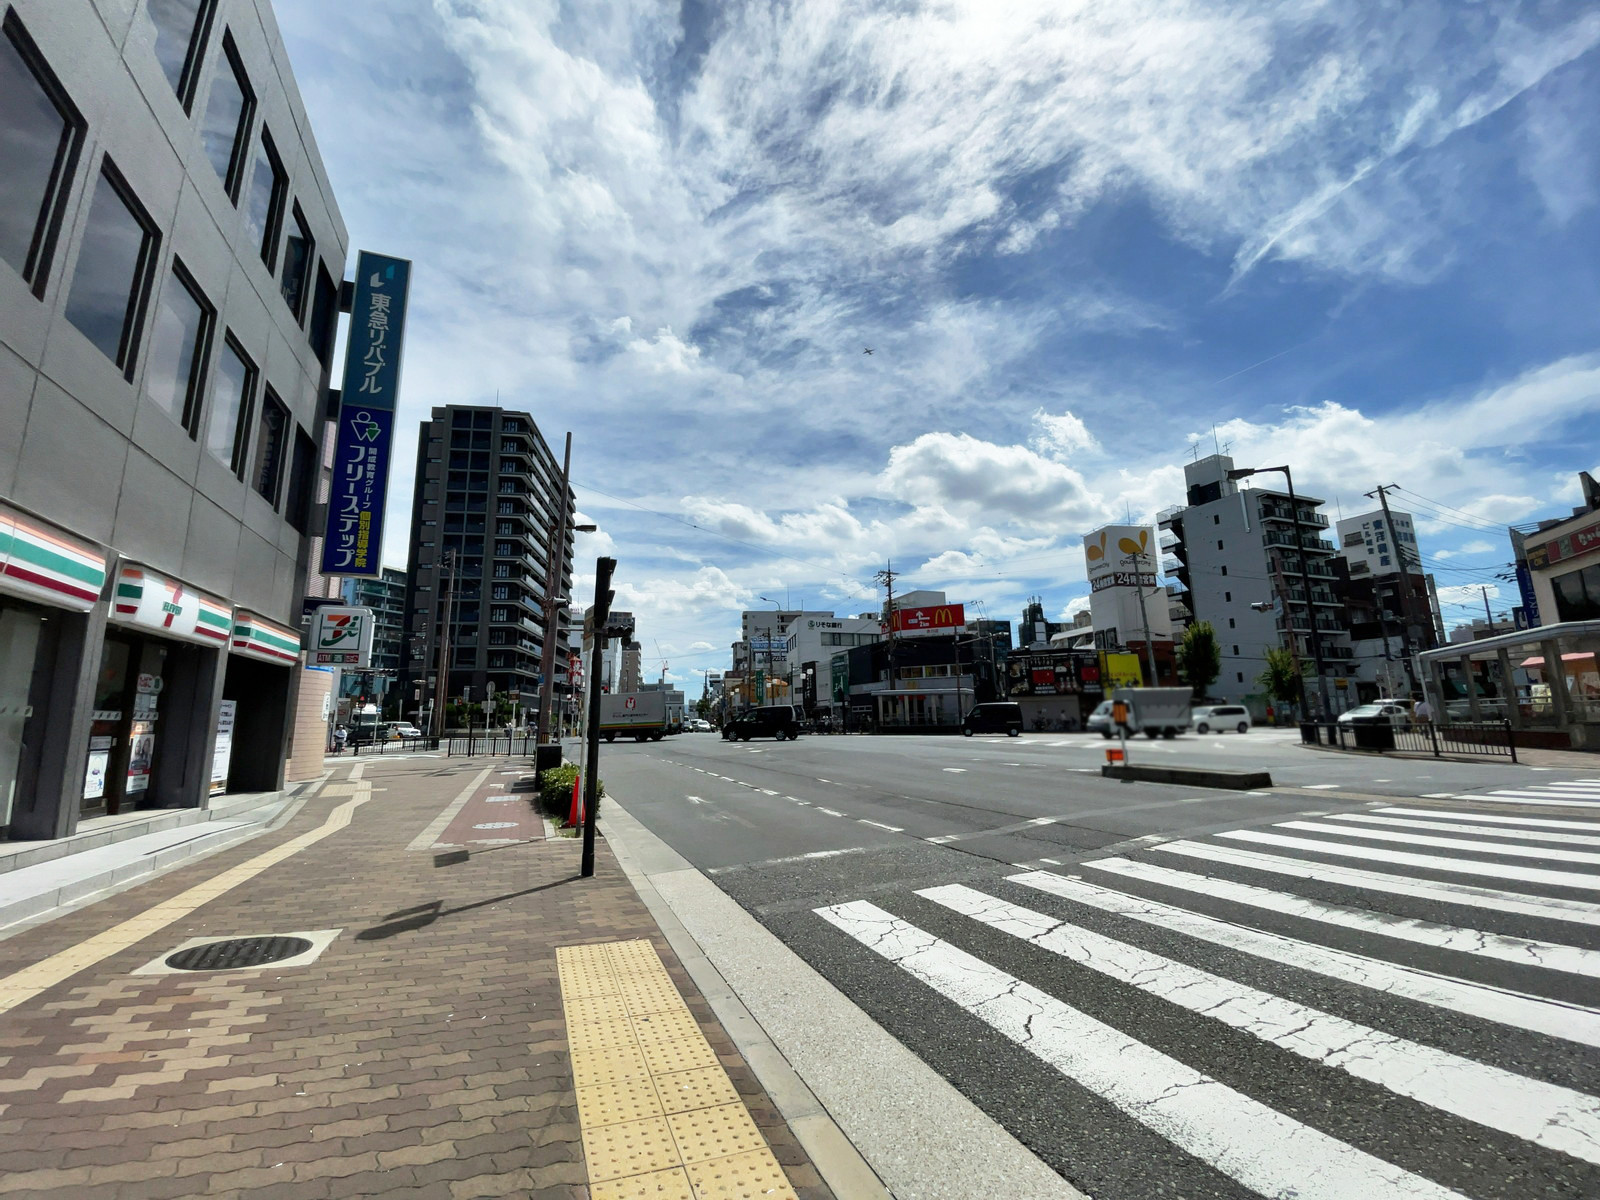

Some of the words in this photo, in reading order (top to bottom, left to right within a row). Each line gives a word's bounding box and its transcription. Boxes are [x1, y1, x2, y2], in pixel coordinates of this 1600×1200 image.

[359, 292, 391, 395] 東急リバブル
[335, 445, 366, 567] フリーステップ
[362, 447, 378, 509] 開成教育グループ
[354, 510, 372, 568] 個別指導学院
[815, 621, 843, 629] りそな銀行
[317, 653, 331, 663] ATM
